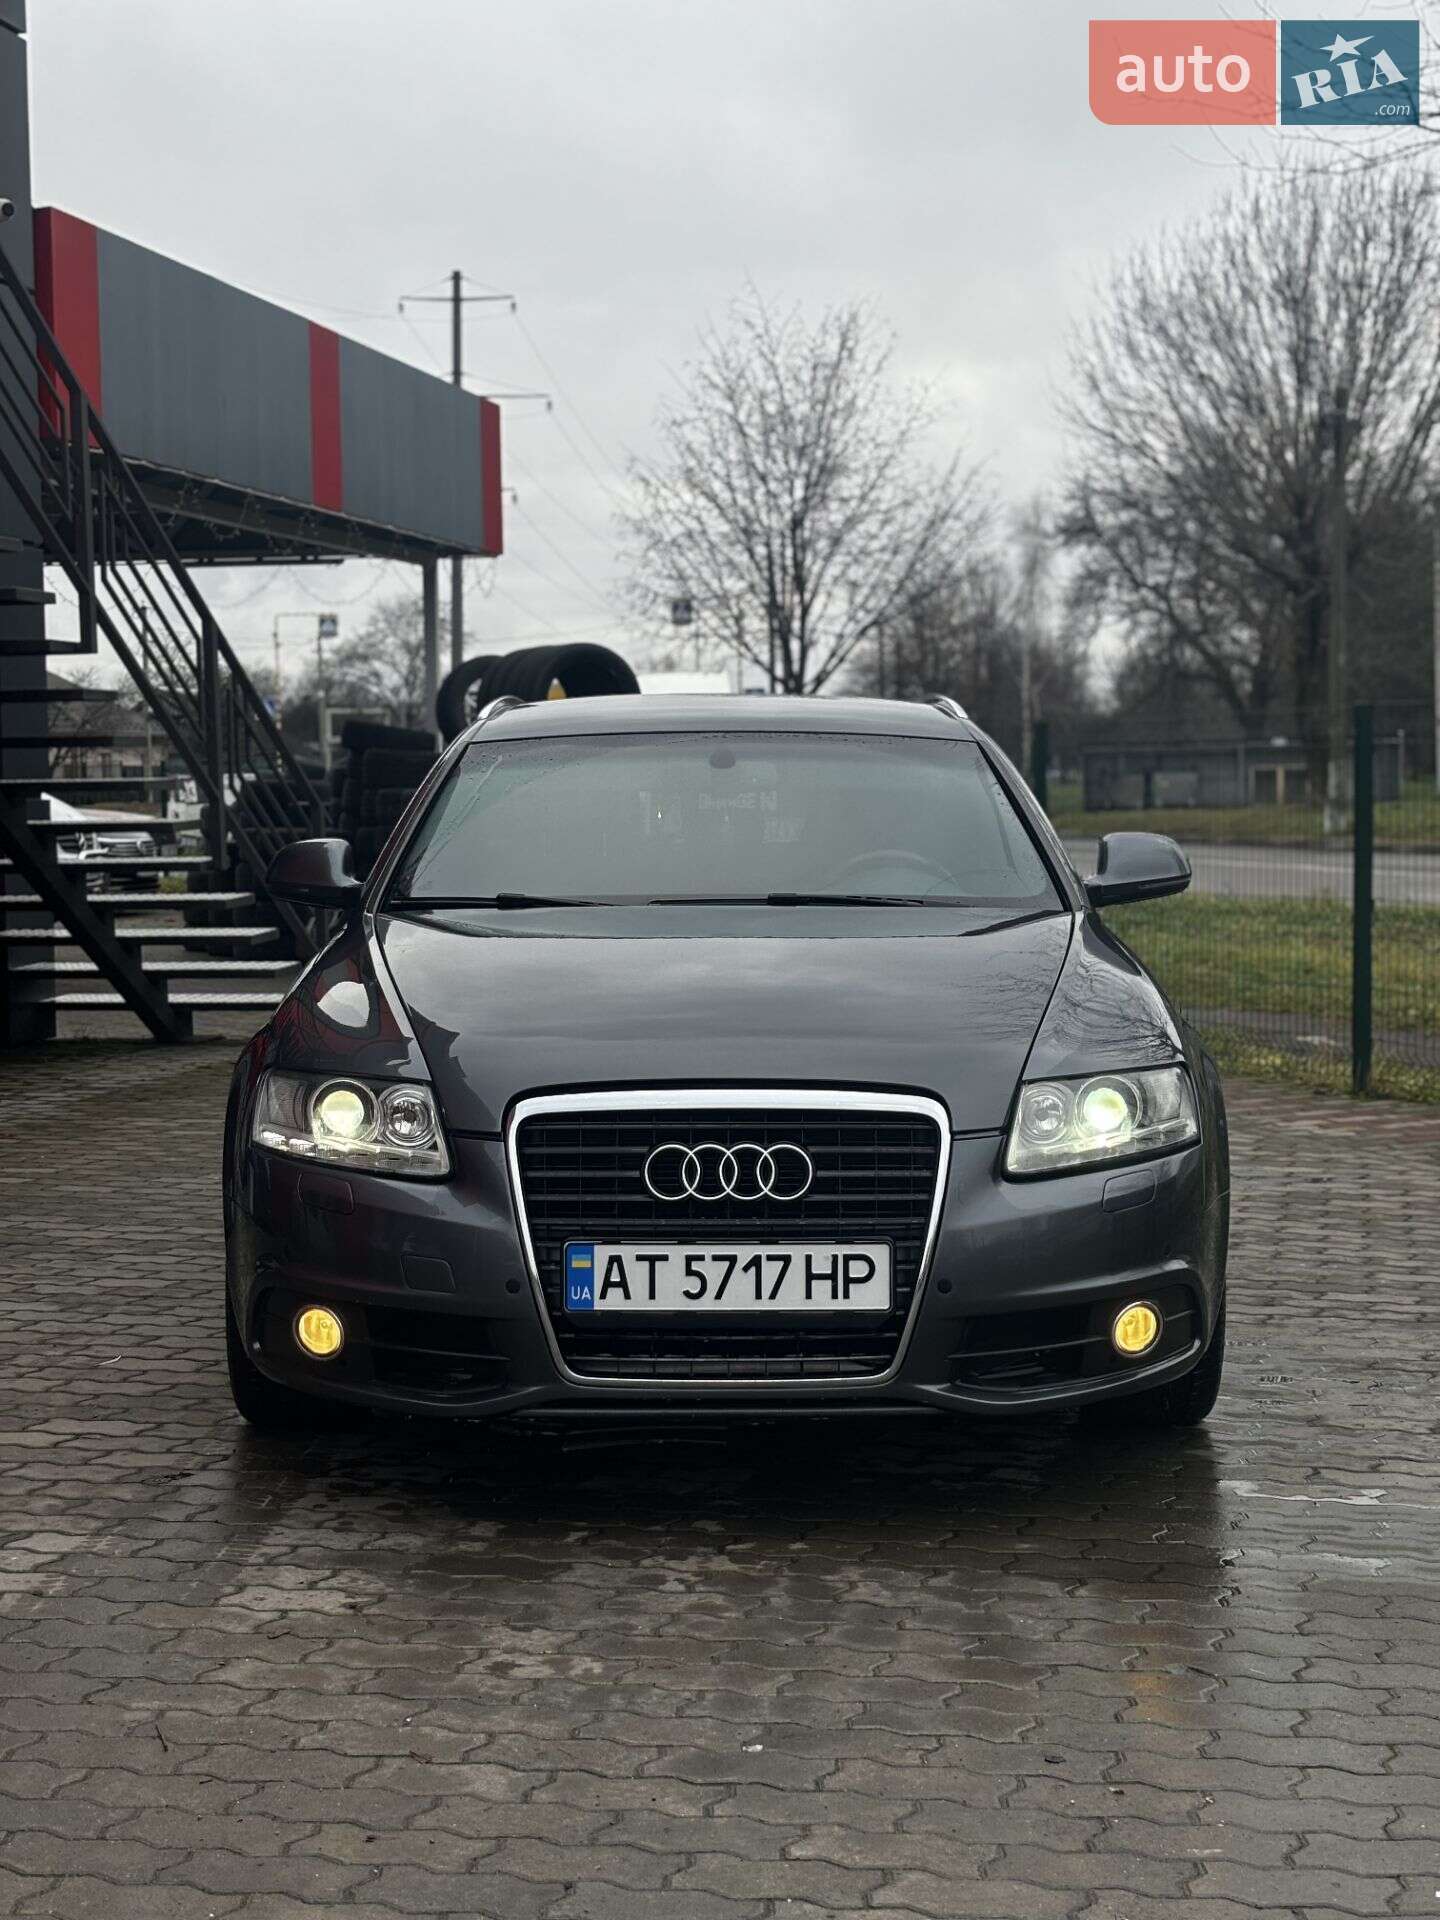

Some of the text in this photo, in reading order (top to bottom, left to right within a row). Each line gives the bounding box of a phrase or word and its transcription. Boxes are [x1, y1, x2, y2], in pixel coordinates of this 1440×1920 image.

[599, 1254, 876, 1301] AT 5717 HP
[571, 1286, 592, 1301] UA
